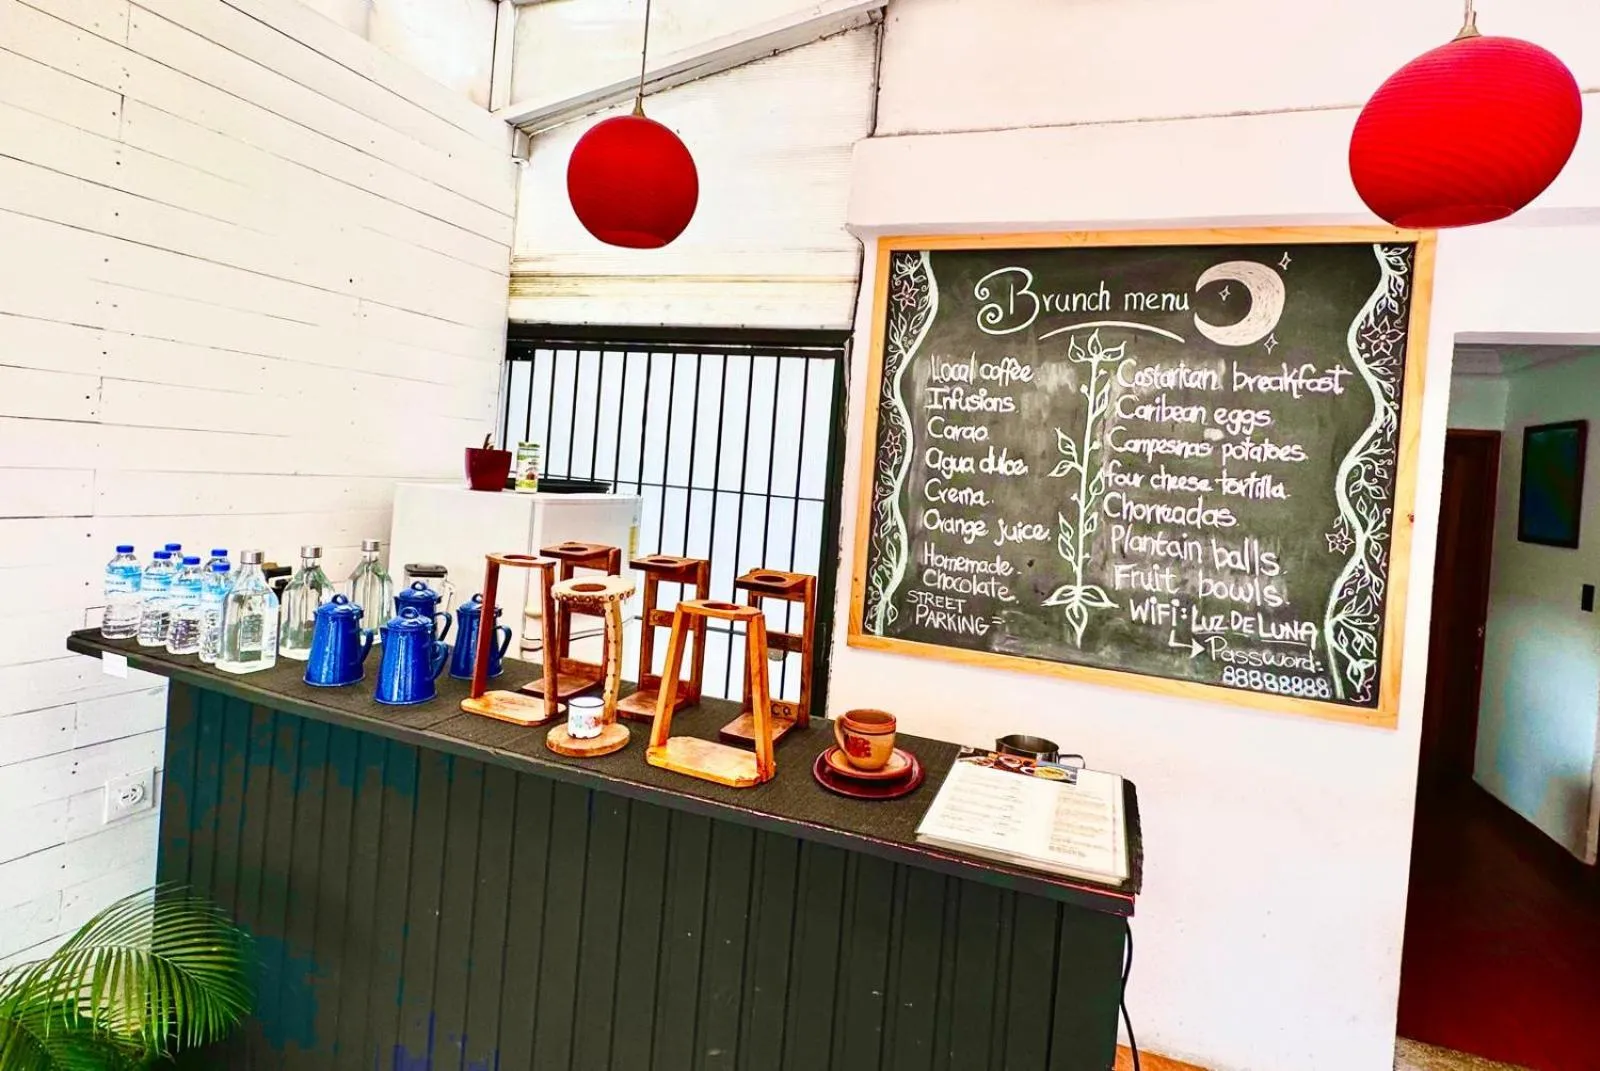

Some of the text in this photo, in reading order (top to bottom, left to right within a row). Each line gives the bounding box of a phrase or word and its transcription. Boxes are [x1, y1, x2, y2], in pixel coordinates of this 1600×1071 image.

[974, 266, 1190, 335] Brunch menu
[931, 351, 976, 385] Local
[1116, 394, 1206, 422] Caribean
[923, 508, 989, 544] Orange
[1111, 524, 1202, 563] Plantain
[1115, 563, 1179, 594] Fruit
[907, 590, 967, 613] STREET
[916, 604, 991, 636] PARKING
[1191, 605, 1230, 632] LUZ
[1230, 610, 1256, 634] DE
[1257, 612, 1317, 650] LUNA
[1222, 665, 1331, 698] 88888888
